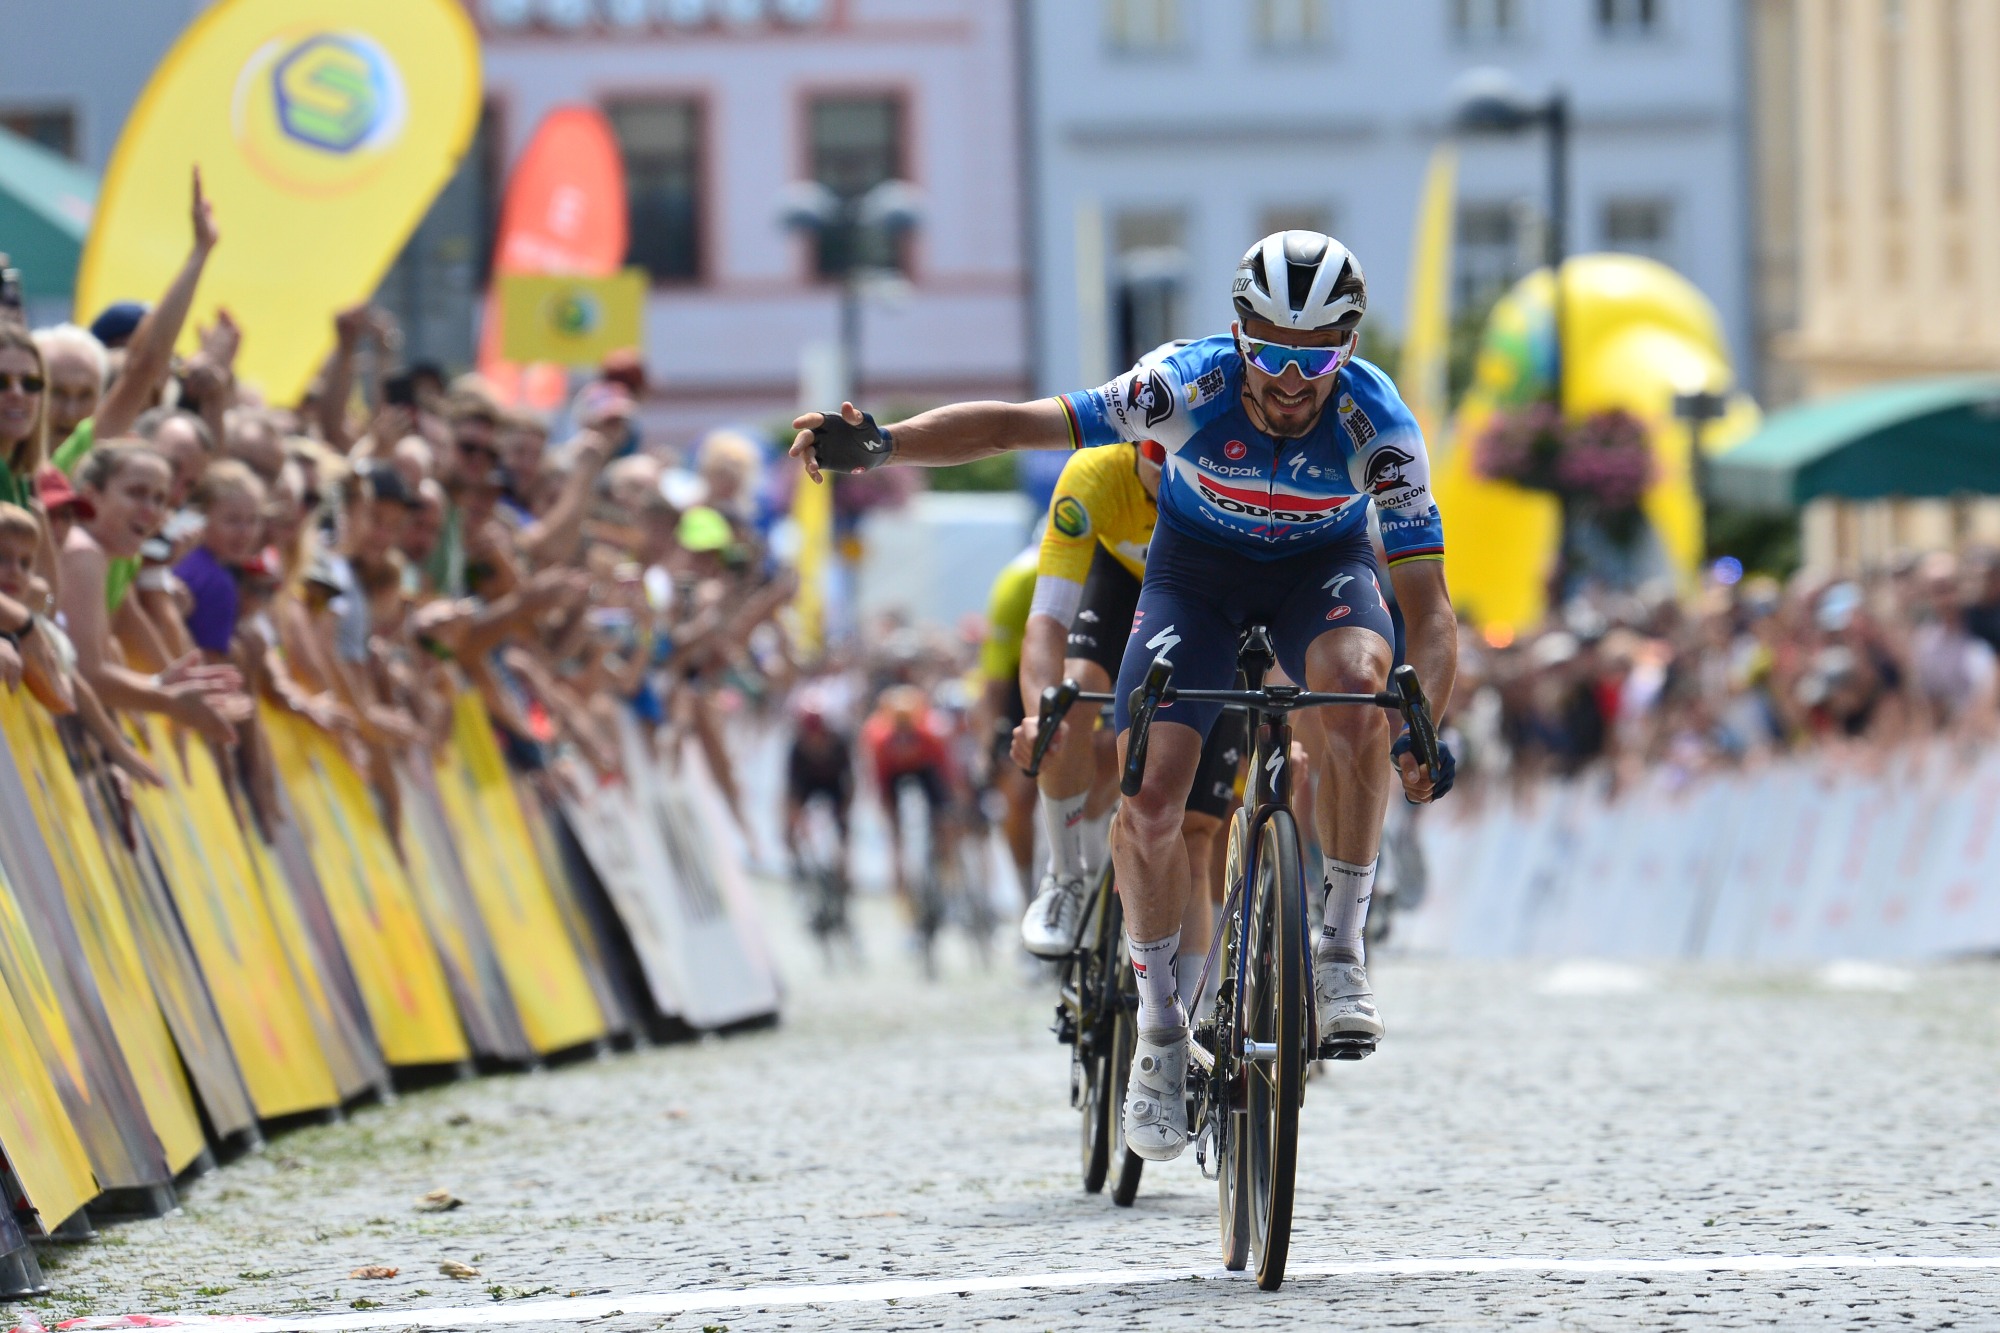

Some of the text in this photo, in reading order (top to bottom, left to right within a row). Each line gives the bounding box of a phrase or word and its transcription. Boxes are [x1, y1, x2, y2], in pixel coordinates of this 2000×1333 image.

[1110, 381, 1127, 424] POLEON
[1346, 415, 1368, 447] JOGGER
[1353, 409, 1376, 439] SAFETY
[1198, 456, 1262, 477] Ekopak
[1374, 484, 1426, 507] APOLEON
